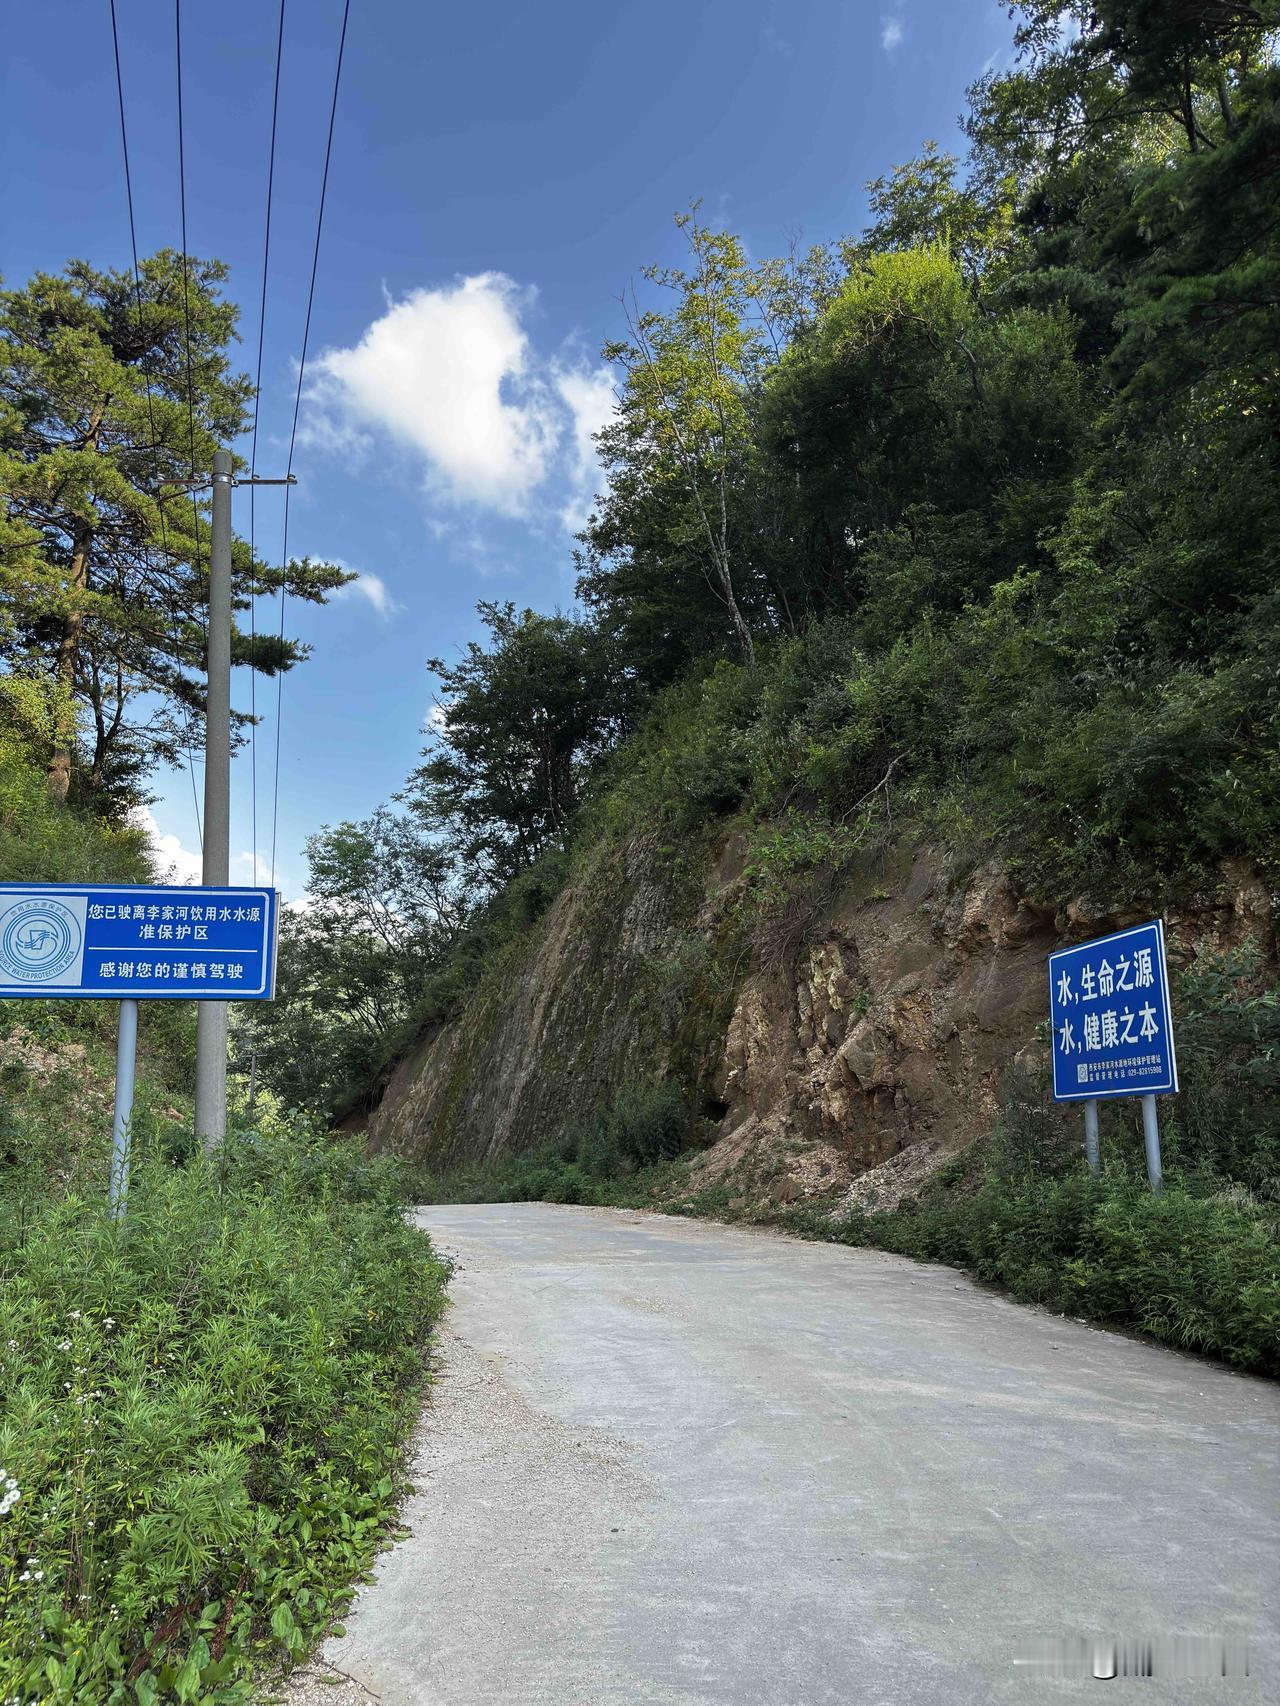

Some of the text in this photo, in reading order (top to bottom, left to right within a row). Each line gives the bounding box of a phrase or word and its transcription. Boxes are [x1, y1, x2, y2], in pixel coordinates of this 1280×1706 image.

[88, 904, 261, 921] 您已驶离李家河饮用水水源
[139, 925, 209, 940] 准保护区
[0, 949, 13, 971] OURCE
[11, 966, 31, 979] WATER
[30, 964, 65, 979] PROTECTION
[99, 962, 243, 979] 感谢您的谨慎驾驶
